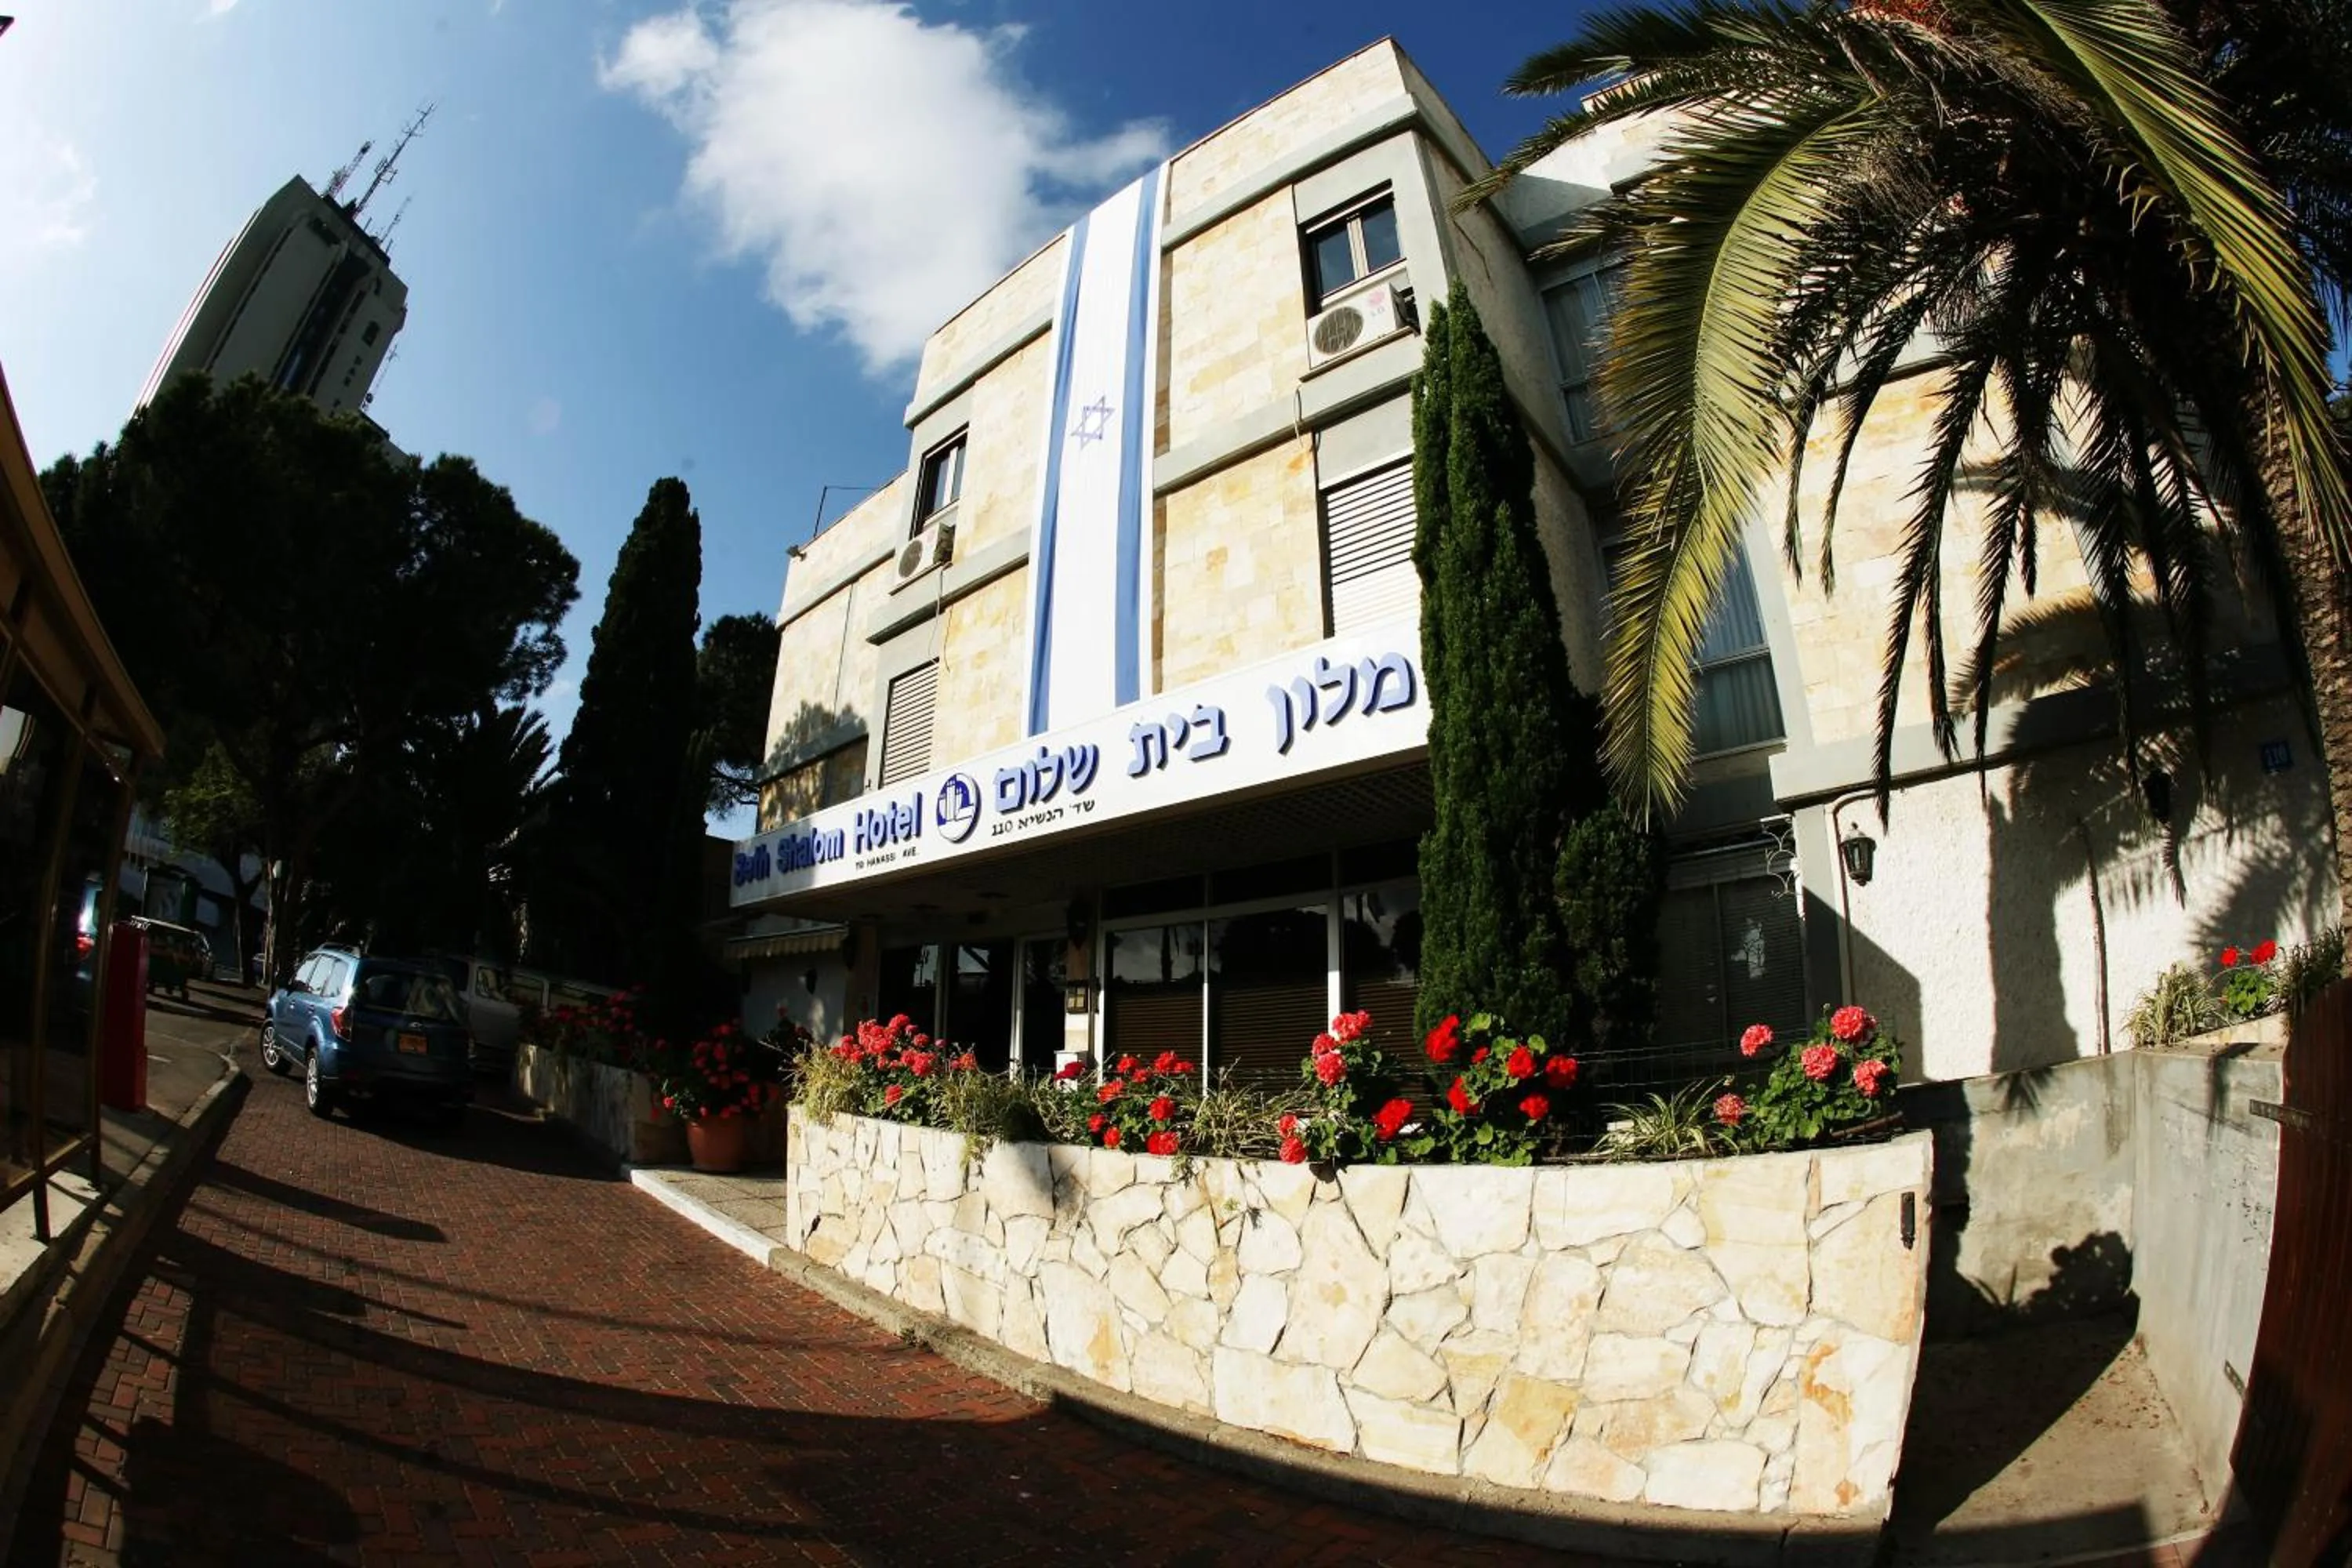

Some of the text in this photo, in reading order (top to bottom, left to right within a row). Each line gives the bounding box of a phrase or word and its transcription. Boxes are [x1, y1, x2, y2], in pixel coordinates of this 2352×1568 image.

[992, 652, 1417, 816] מלון בית שלום
[991, 819, 1014, 837] 110
[1018, 808, 1065, 829] הנשיא
[734, 790, 924, 887] Beth Shalom Hotel
[866, 852, 896, 868] HANASSI
